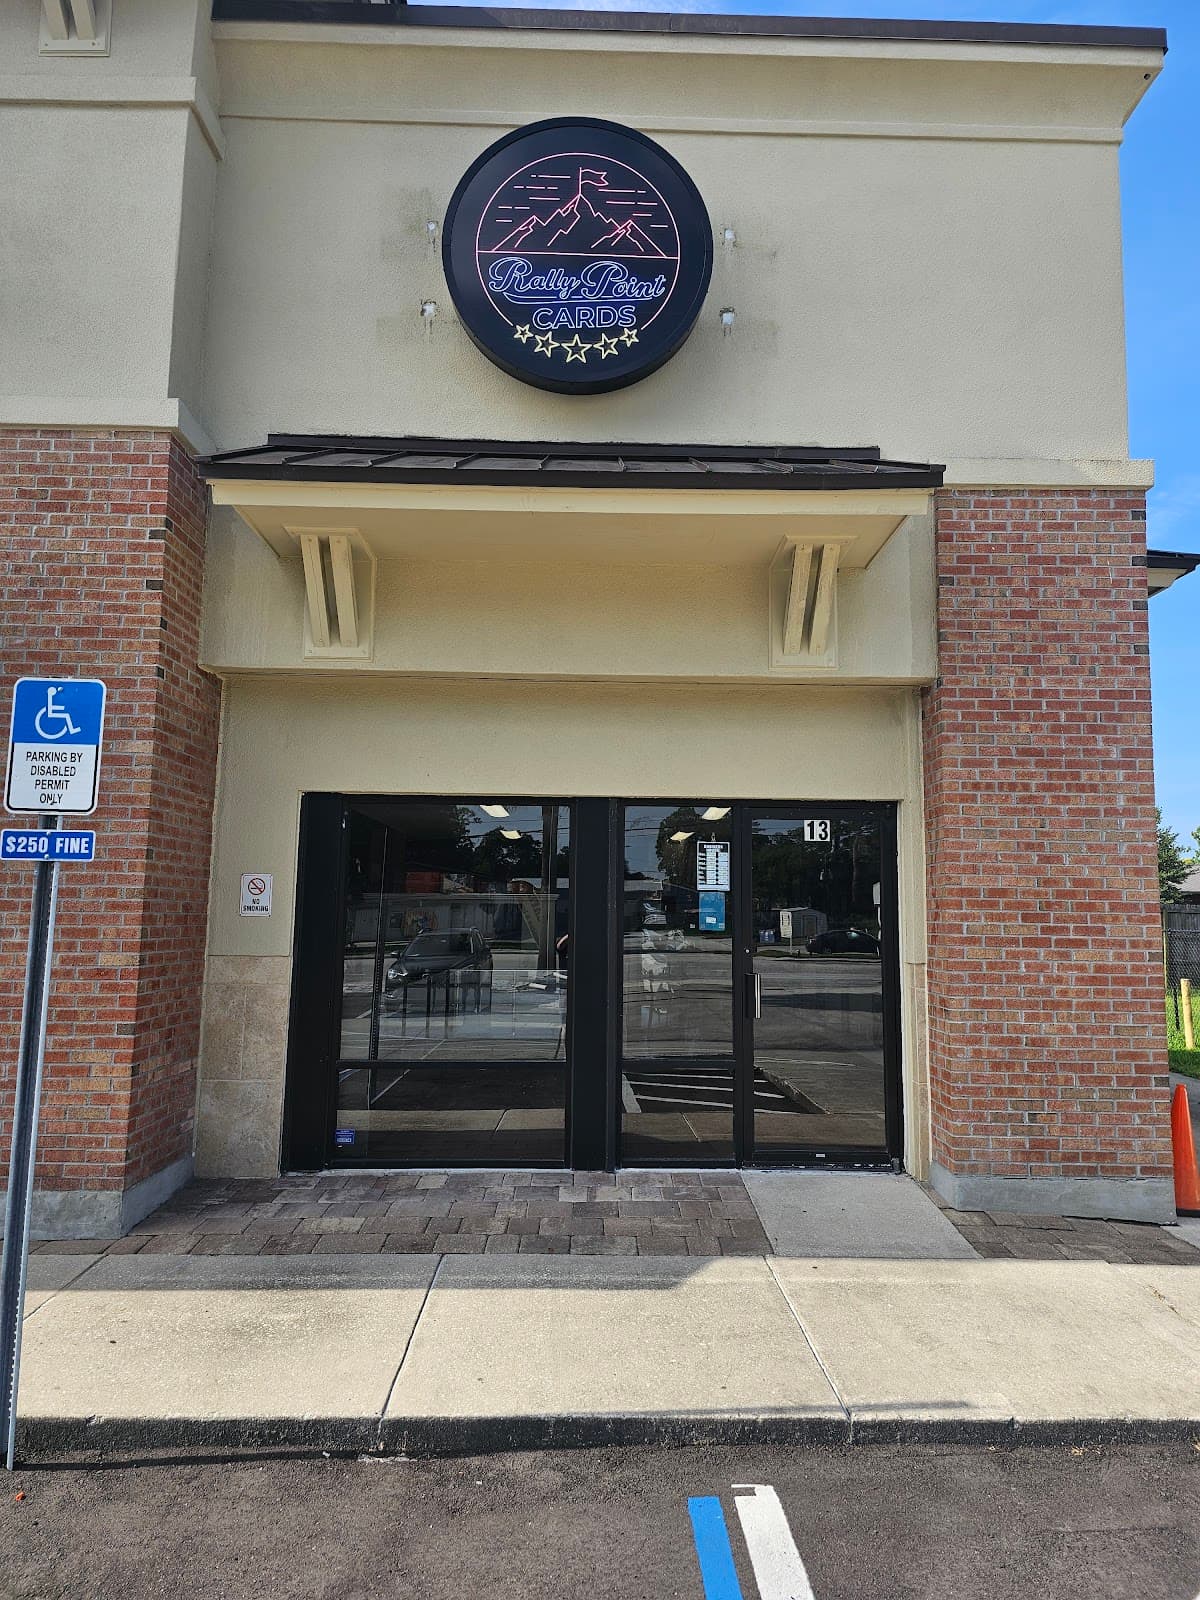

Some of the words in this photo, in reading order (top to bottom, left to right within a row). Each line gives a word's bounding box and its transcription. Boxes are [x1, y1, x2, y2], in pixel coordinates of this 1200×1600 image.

[488, 256, 580, 299] Rally
[581, 260, 667, 298] Point
[532, 305, 637, 330] CARDS
[26, 751, 67, 763] PARKING
[70, 753, 83, 763] BY
[30, 765, 76, 777] DISABLED
[34, 779, 70, 790] PERMIT
[39, 793, 63, 804] ONLY
[807, 820, 828, 840] 13
[5, 835, 49, 853] $250
[55, 837, 89, 854] FINE
